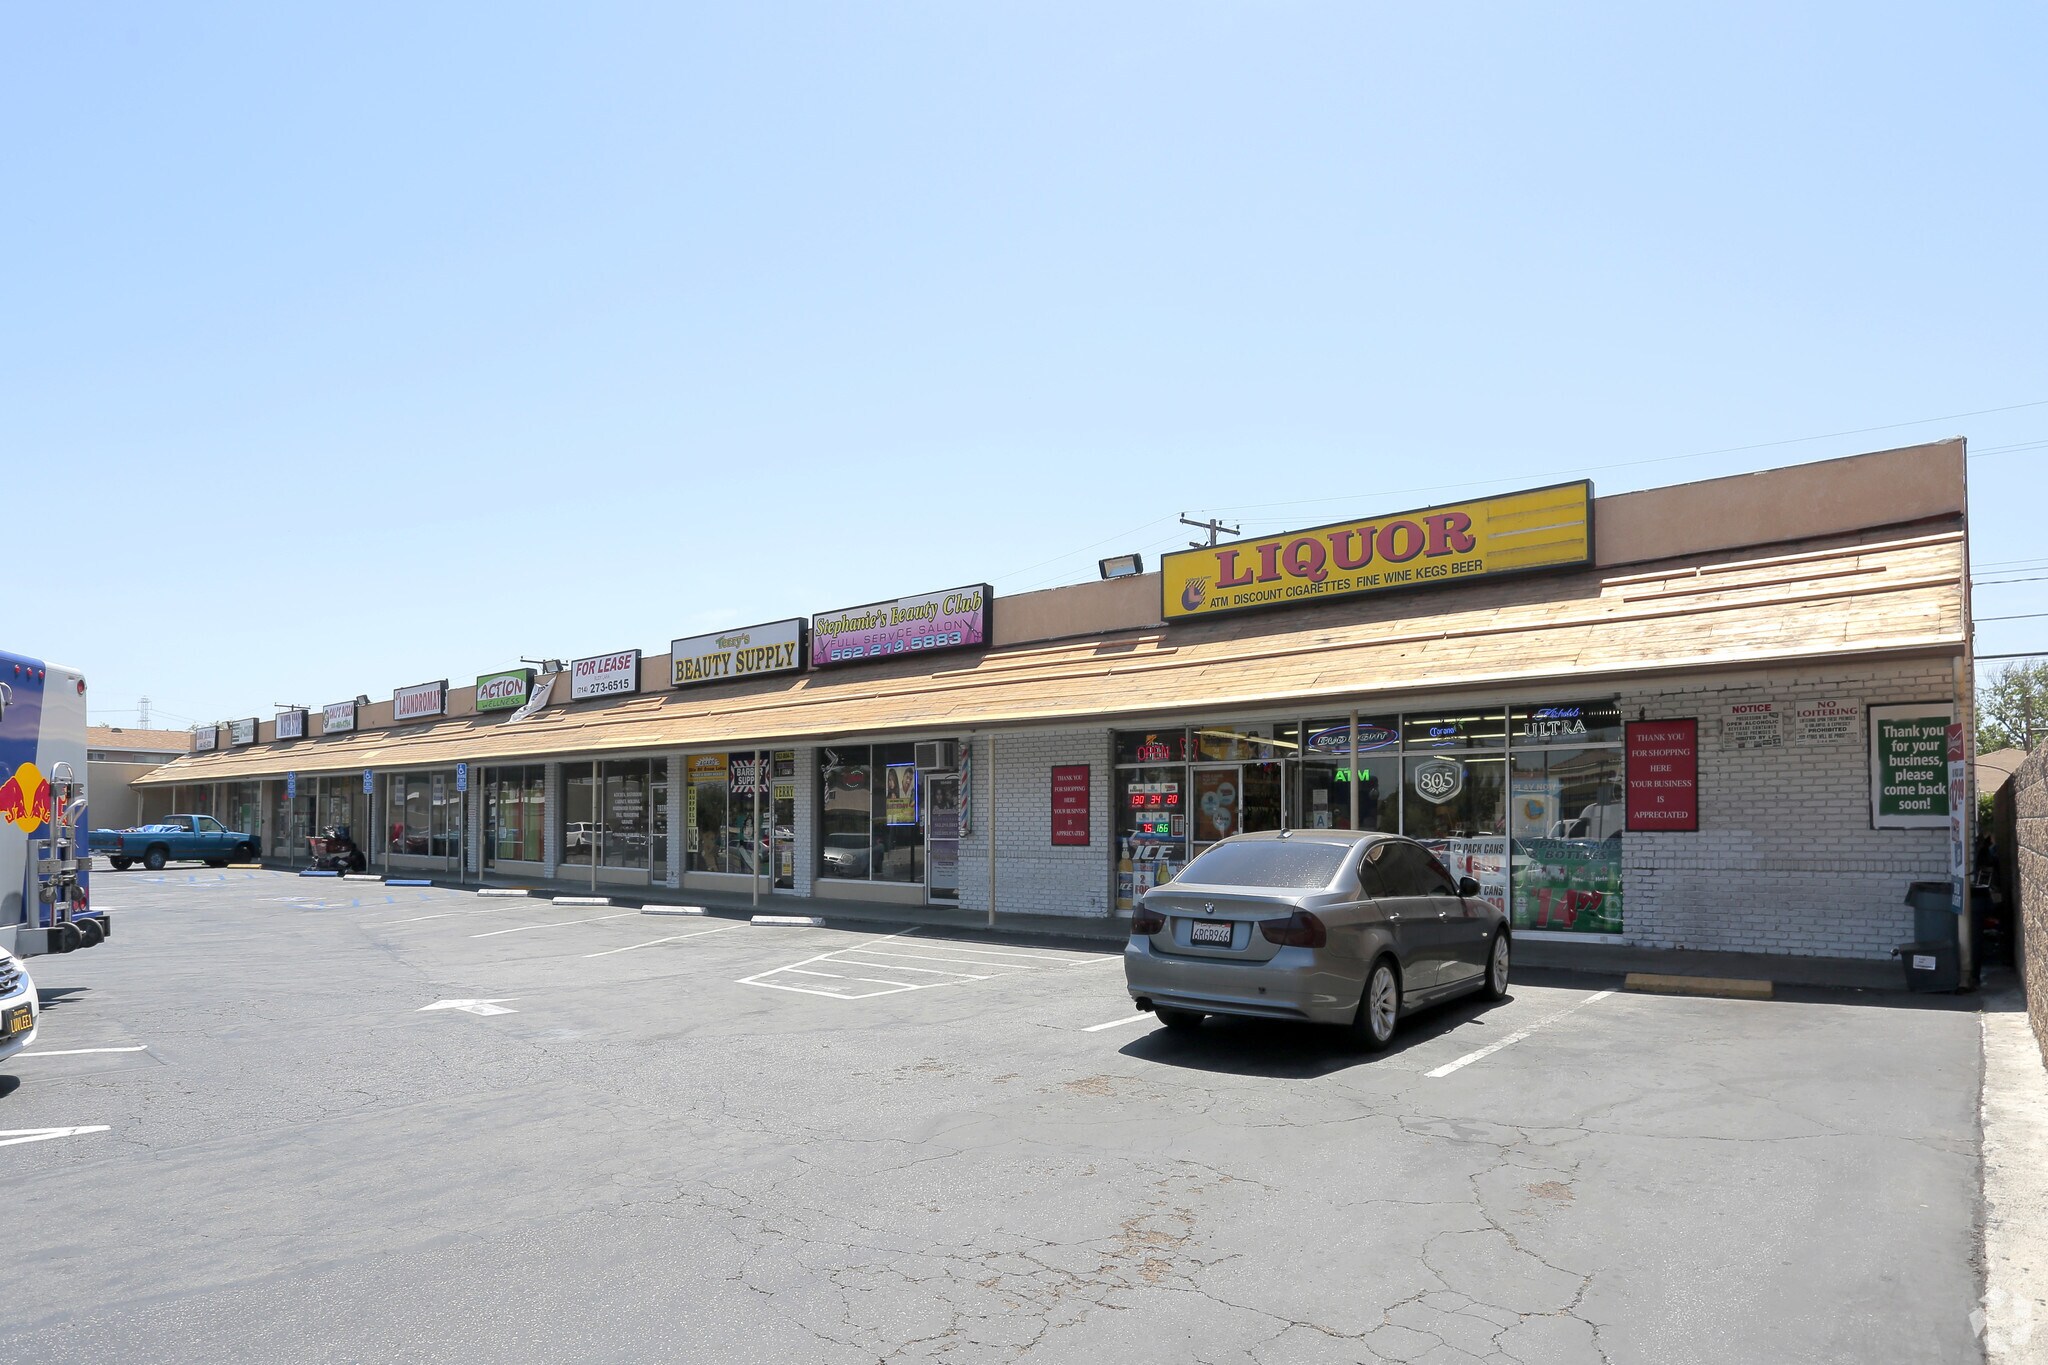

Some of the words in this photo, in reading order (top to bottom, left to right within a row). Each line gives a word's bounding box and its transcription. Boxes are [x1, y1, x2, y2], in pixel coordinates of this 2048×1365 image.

[1215, 512, 1476, 589] LIQUOR
[1210, 596, 1229, 608] ATM
[1234, 588, 1283, 605] DISCOUNT
[1286, 578, 1351, 597] CIGARETTES
[1356, 574, 1380, 587] FINE
[1384, 569, 1412, 583] WINE
[1416, 564, 1448, 579] KEGS
[1451, 559, 1483, 574] BEER
[815, 609, 887, 638] Stephanie's
[891, 600, 938, 625] Beauty
[942, 591, 983, 615] Club
[830, 639, 857, 648] FULL
[919, 620, 962, 633] SALON
[715, 633, 750, 649] Terry's
[830, 631, 961, 660] 562.219.5883
[576, 660, 596, 676] FOR
[598, 655, 632, 673] LEASE
[675, 652, 732, 681] BEAUTY
[735, 641, 796, 674] SUPPLY
[480, 679, 523, 699] ACTION
[590, 678, 629, 693] 273-6515
[400, 690, 441, 715] LAUNDROMAT
[482, 698, 520, 709] WELLNESS
[1817, 700, 1837, 708] NO
[1732, 704, 1772, 714] NOTICE
[1797, 707, 1858, 717] LOITERING
[1430, 727, 1455, 737] Corona
[1524, 719, 1587, 737] ULTRA
[1883, 724, 1920, 738] Thank
[1922, 726, 1944, 740] you
[1636, 733, 1665, 741] THANK
[1667, 732, 1685, 740] YOU
[1138, 744, 1169, 761] OPEN
[1632, 749, 1648, 757] FOR
[1649, 748, 1690, 756] SHOPPING
[1891, 740, 1909, 752] for
[1912, 741, 1940, 754] your
[1889, 754, 1943, 767] business,
[736, 767, 763, 776] BARBR
[1650, 764, 1672, 772] HERE
[738, 776, 761, 785] SUPP
[1421, 772, 1454, 789] 805
[1895, 768, 1934, 784] please
[1631, 780, 1653, 788] YOUR
[1654, 779, 1692, 787] BUSINESS
[1884, 785, 1915, 795] come
[1918, 782, 1946, 795] back
[775, 786, 794, 798] TERRY
[1132, 795, 1145, 805] 130
[1151, 795, 1161, 804] 34
[1167, 794, 1178, 804] 20
[1657, 795, 1665, 803] IS
[1899, 797, 1931, 810] soon!
[1317, 815, 1325, 827] A
[1633, 811, 1689, 819] APPRECIATED
[1143, 823, 1153, 833] 75
[1132, 845, 1175, 860] ICE
[1453, 843, 1461, 854] 12
[1463, 843, 1482, 854] PACK
[1484, 843, 1504, 854] CANS
[1140, 874, 1146, 884] 2
[1119, 883, 1132, 891] ICE
[1484, 885, 1504, 896] CANS
